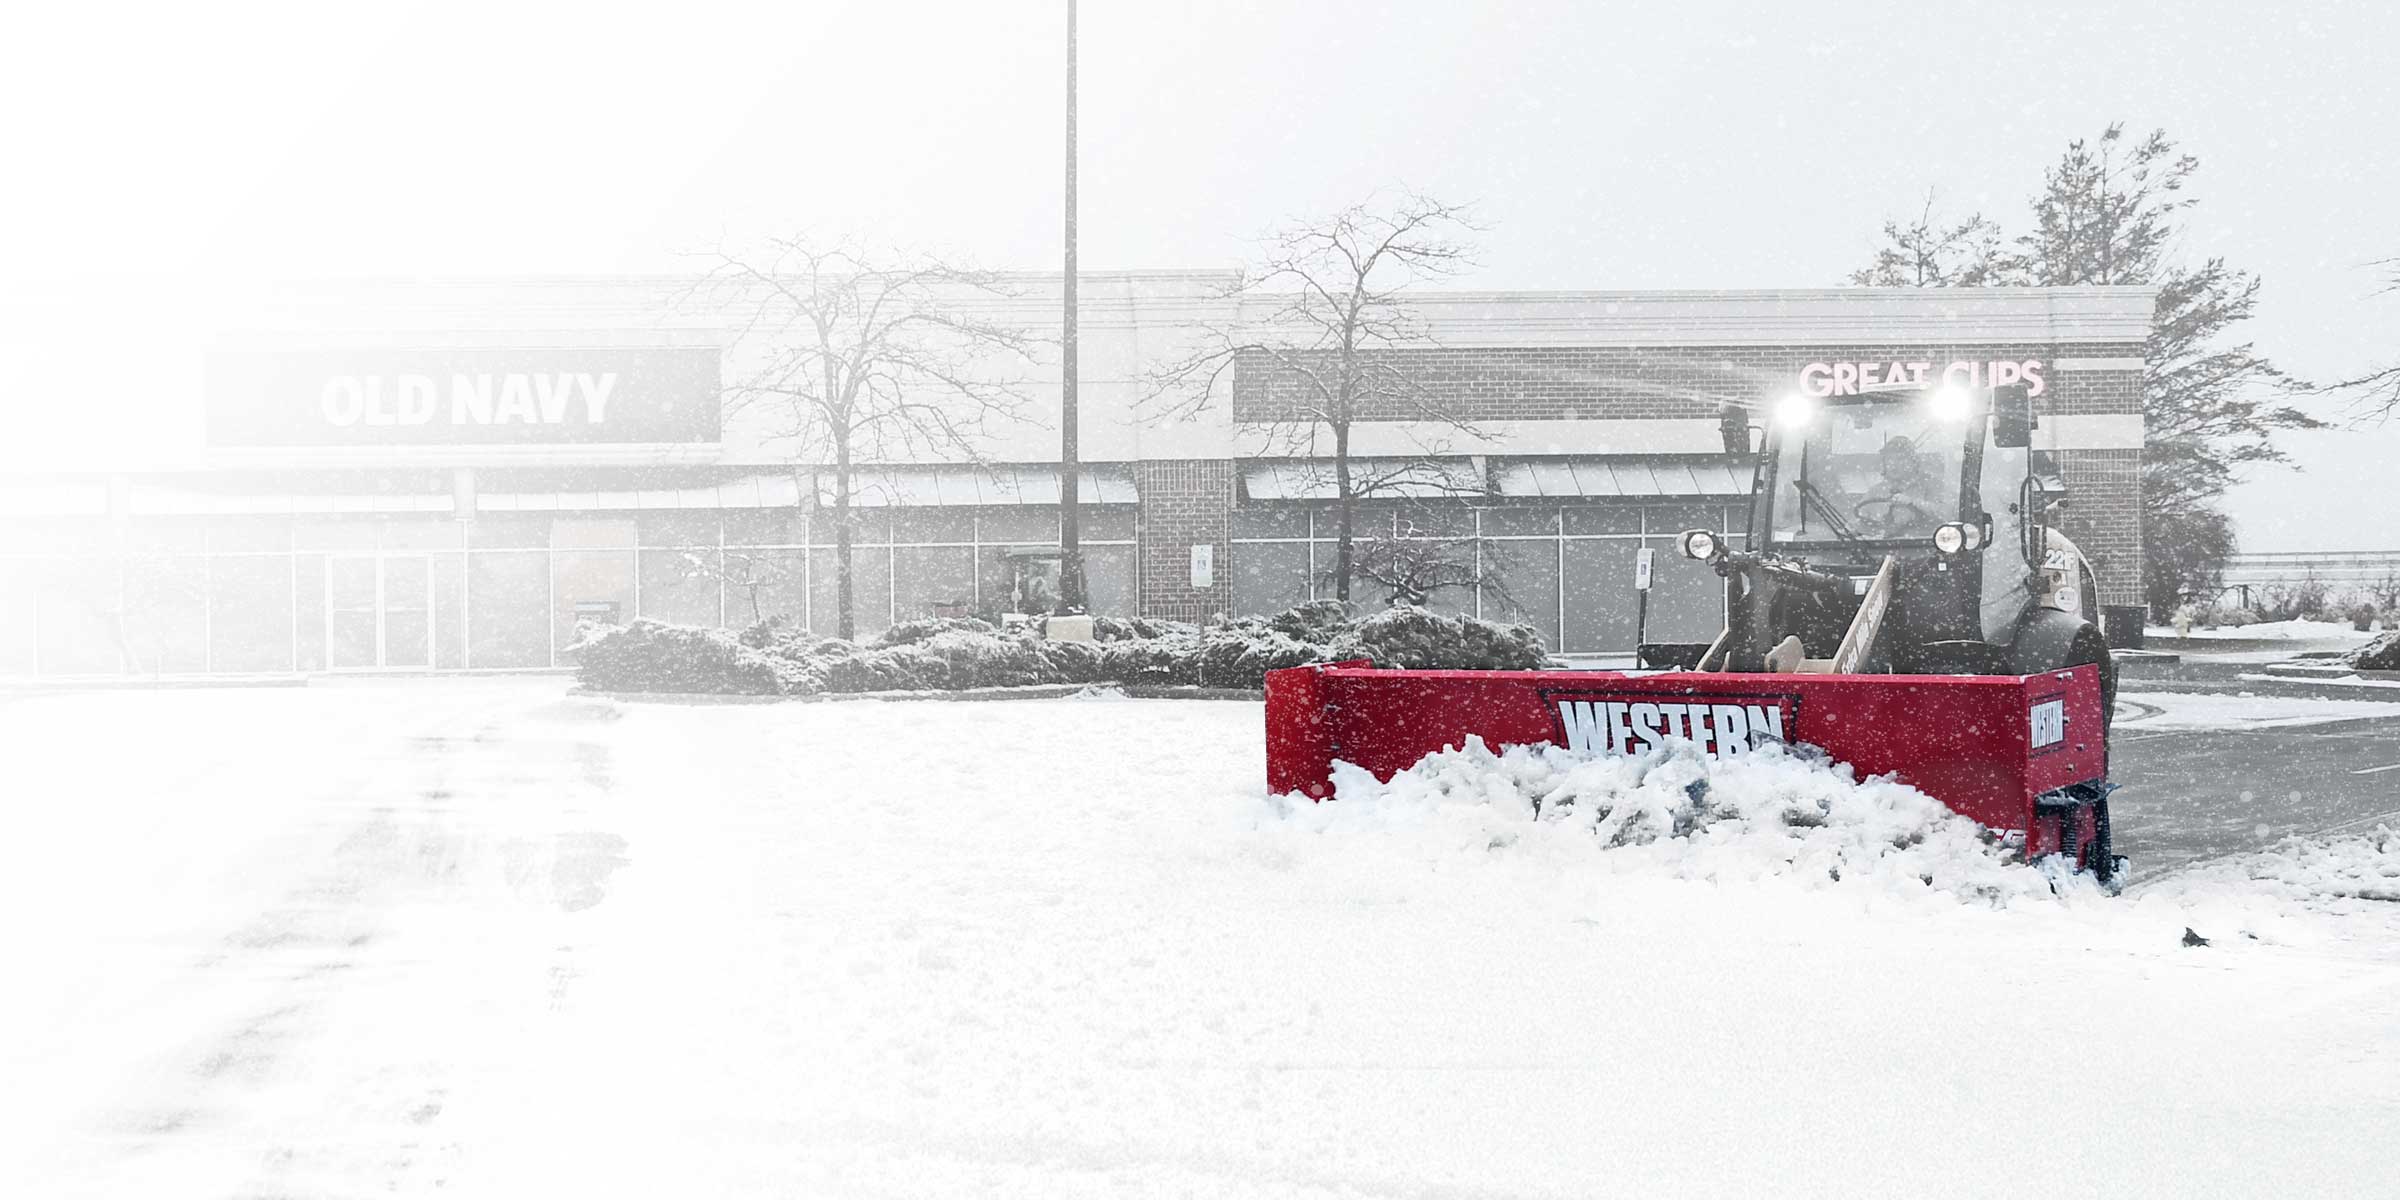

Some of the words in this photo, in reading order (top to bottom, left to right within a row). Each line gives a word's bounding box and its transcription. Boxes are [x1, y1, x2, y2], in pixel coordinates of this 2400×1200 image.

[320, 375, 437, 426] OLD
[451, 372, 617, 425] NAVY
[1800, 361, 1931, 397] GREAT
